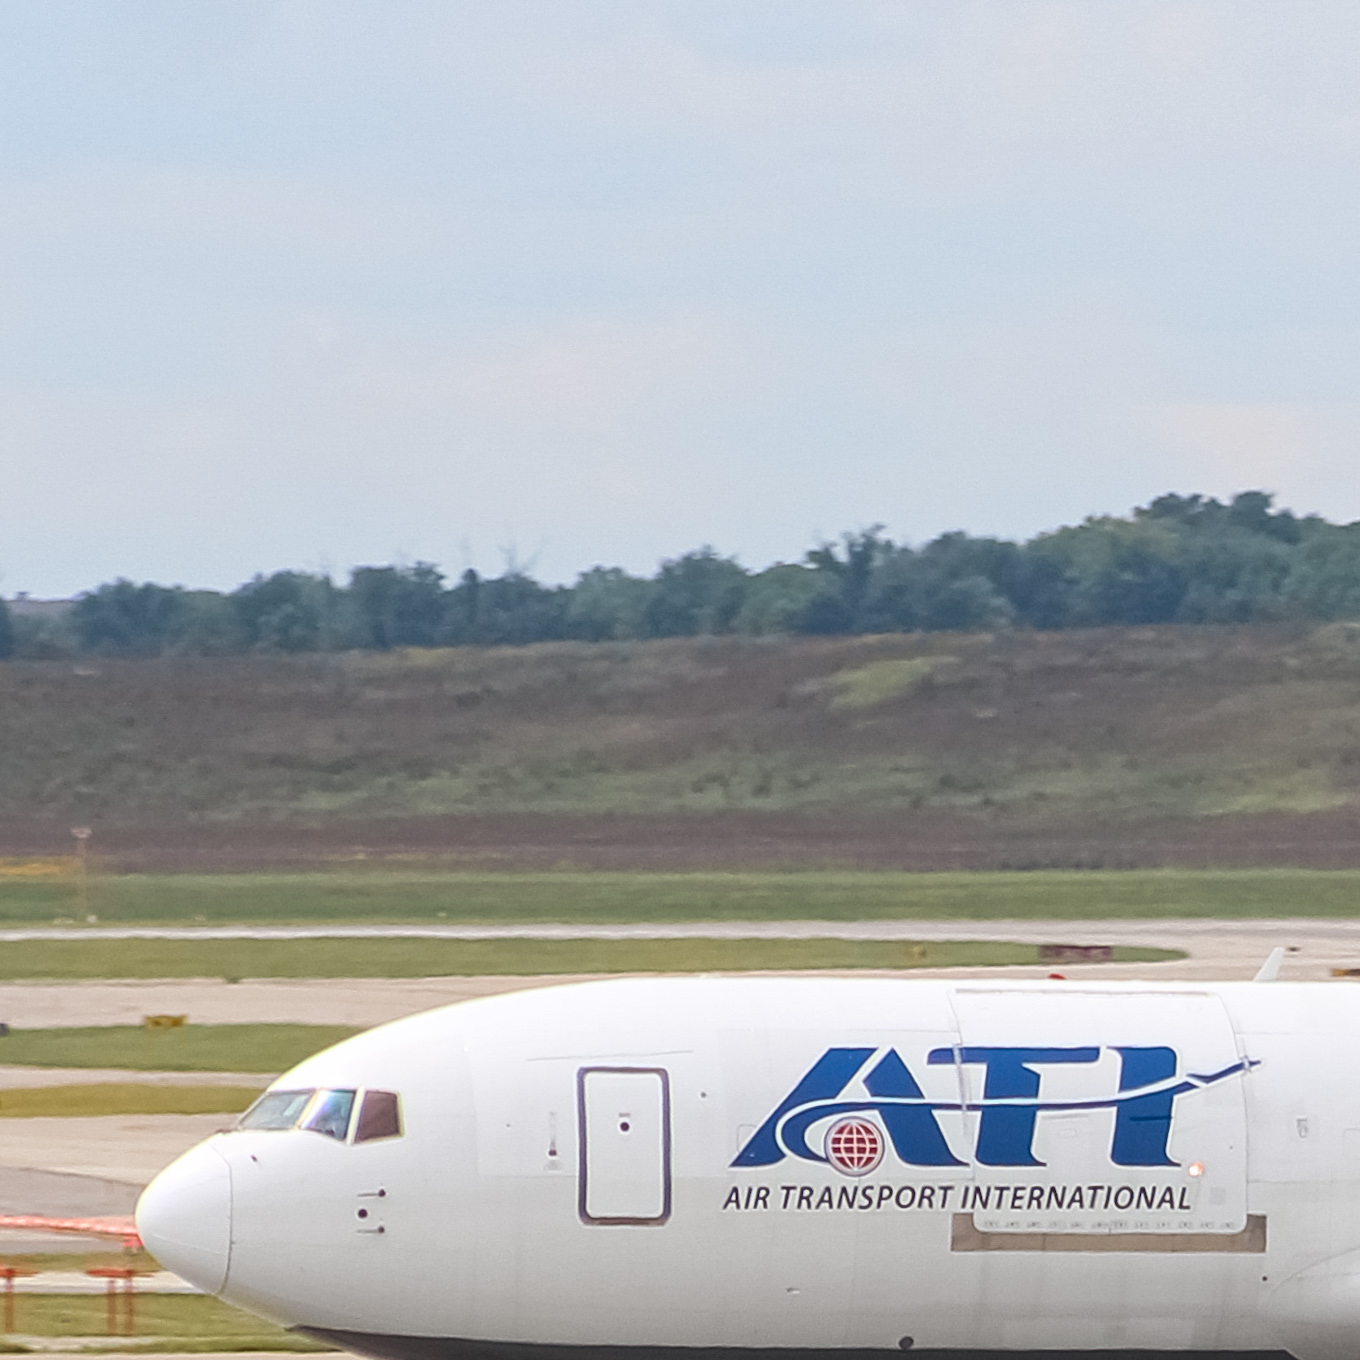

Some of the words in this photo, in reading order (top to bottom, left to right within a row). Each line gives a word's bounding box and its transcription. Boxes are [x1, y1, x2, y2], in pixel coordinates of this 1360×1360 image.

[728, 1047, 1183, 1168] ATI
[722, 1186, 770, 1210] AIR
[780, 1185, 954, 1210] TRANSPORT
[960, 1186, 1191, 1210] INTERNATIONAL
